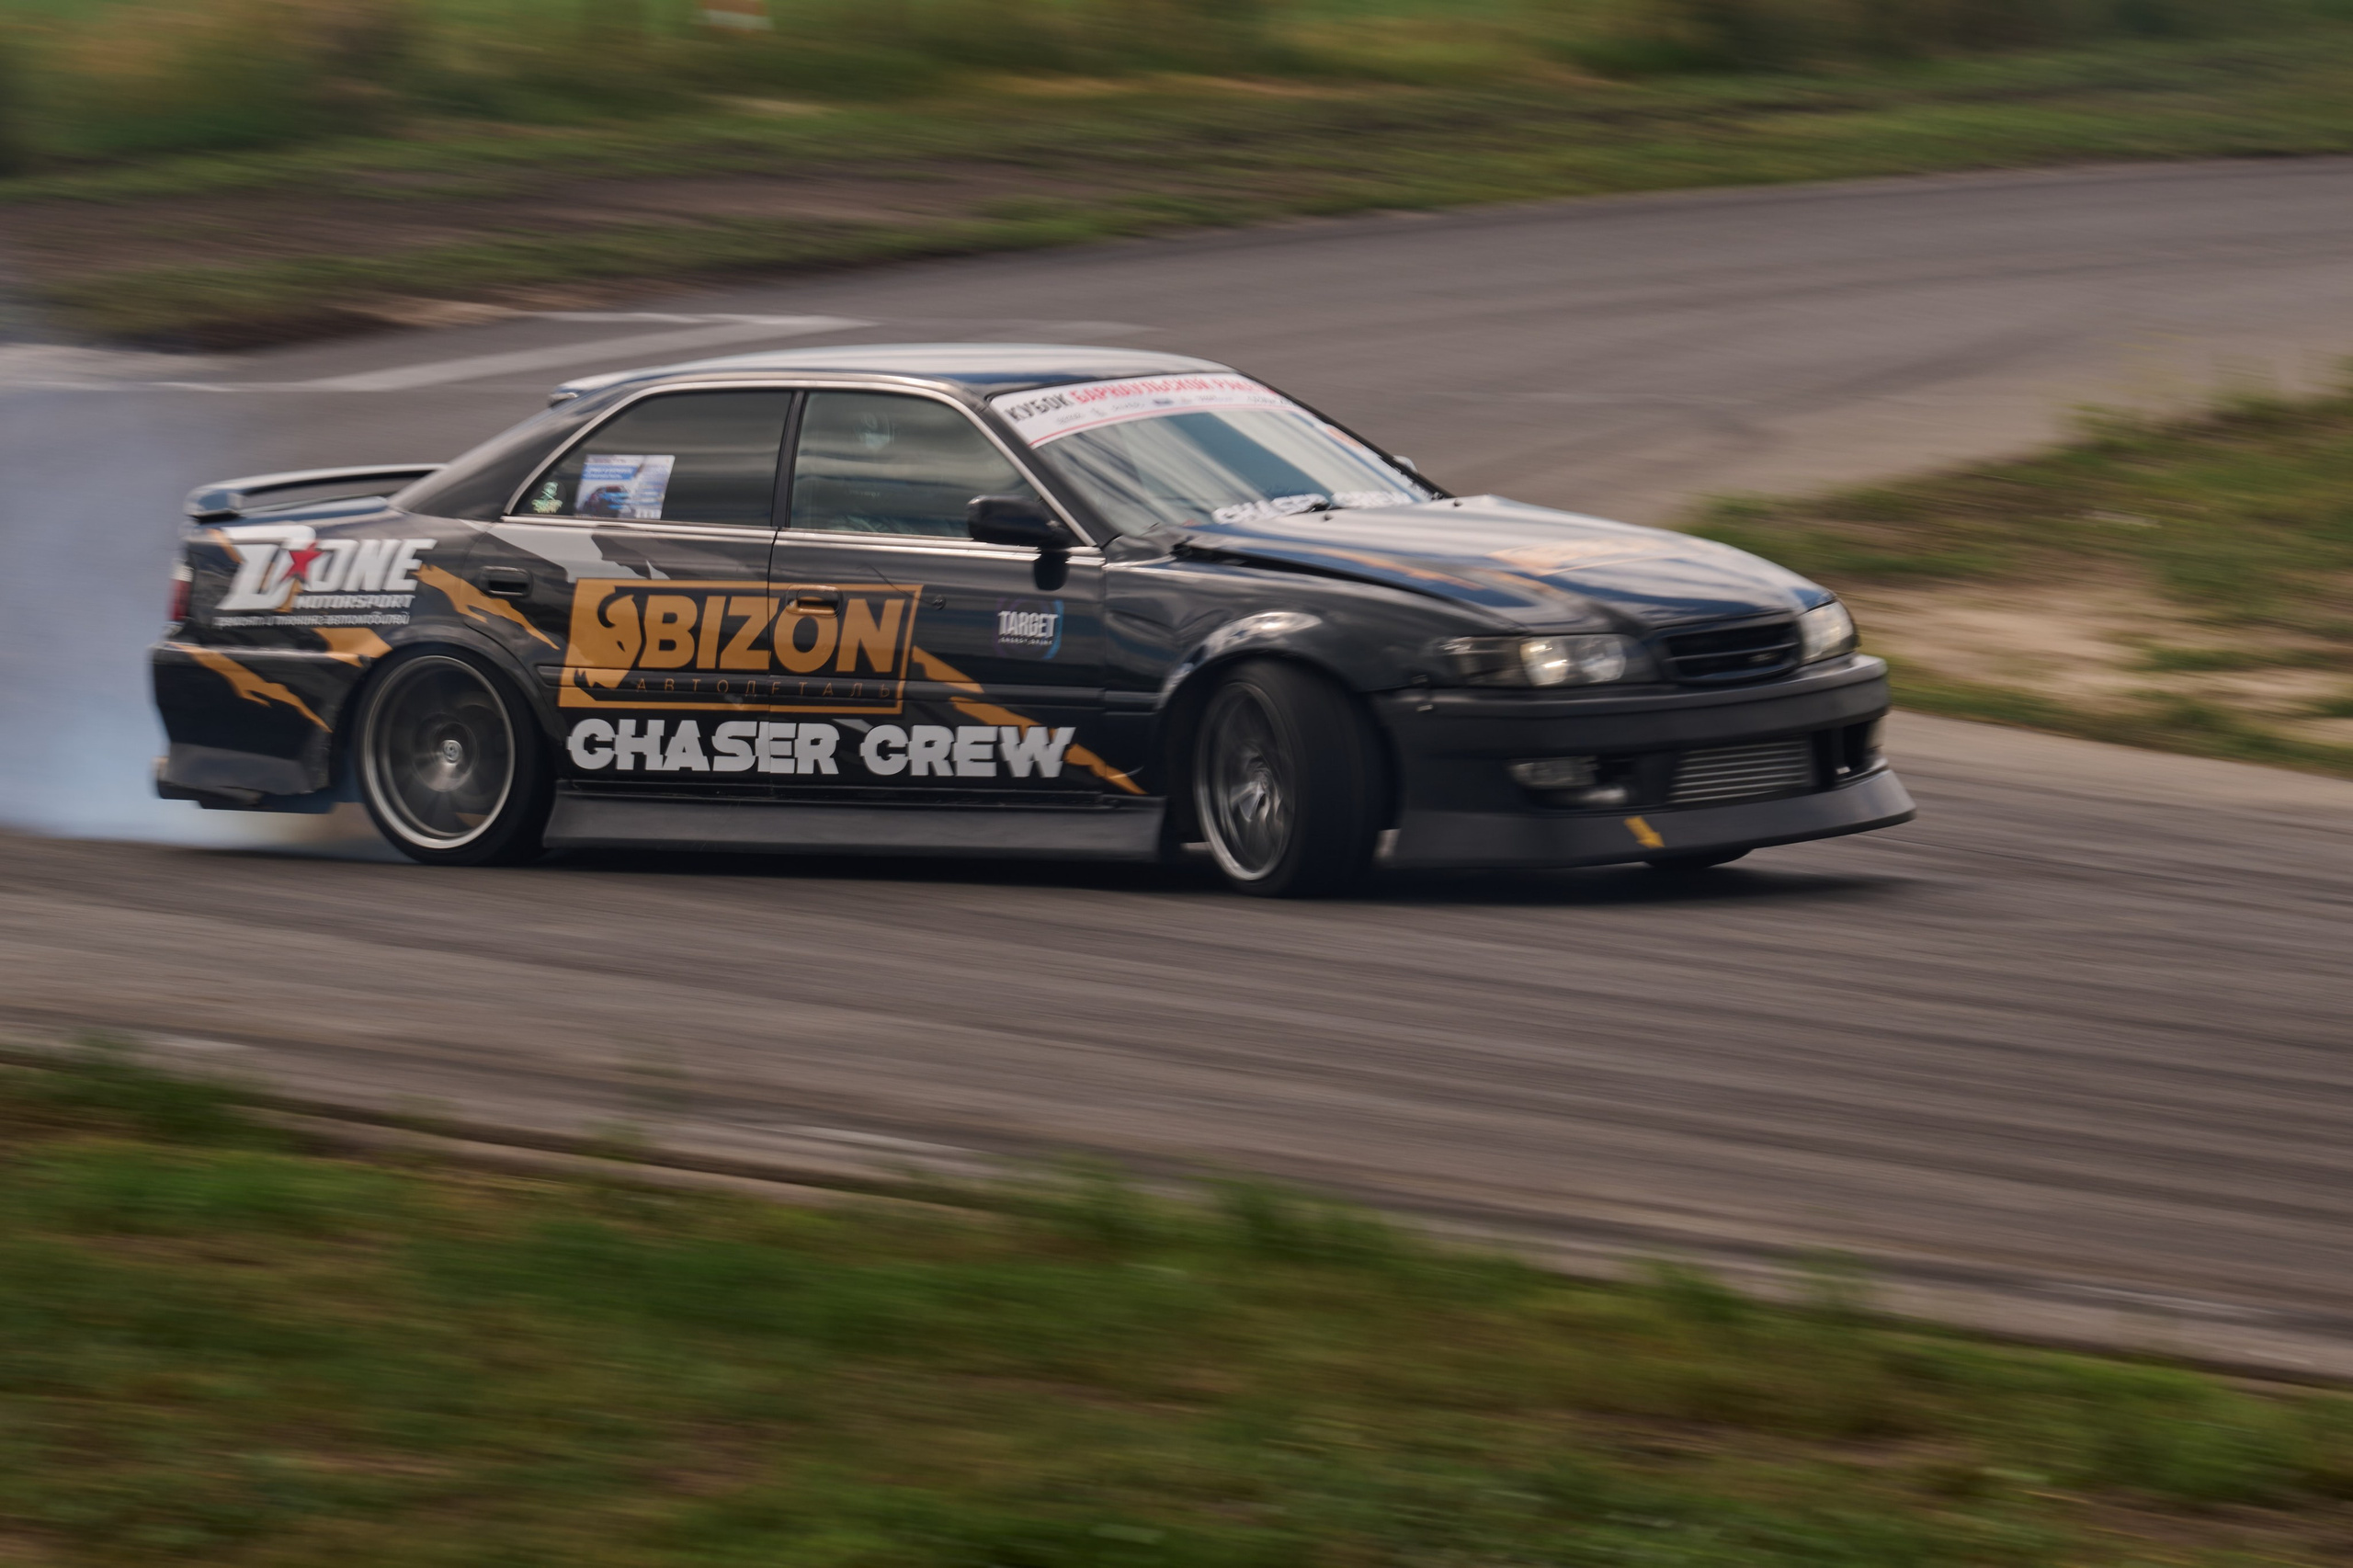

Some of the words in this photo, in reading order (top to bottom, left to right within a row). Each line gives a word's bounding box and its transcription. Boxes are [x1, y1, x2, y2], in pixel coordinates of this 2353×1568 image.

[1005, 392, 1074, 422] КУБОК
[290, 595, 415, 609] MOTORSPORT
[639, 594, 905, 673] BIZON
[997, 610, 1059, 639] TARGET
[635, 677, 891, 699] АВТОДЕТАЛЬ
[567, 718, 839, 775] CHASER
[860, 724, 1076, 778] CREW
